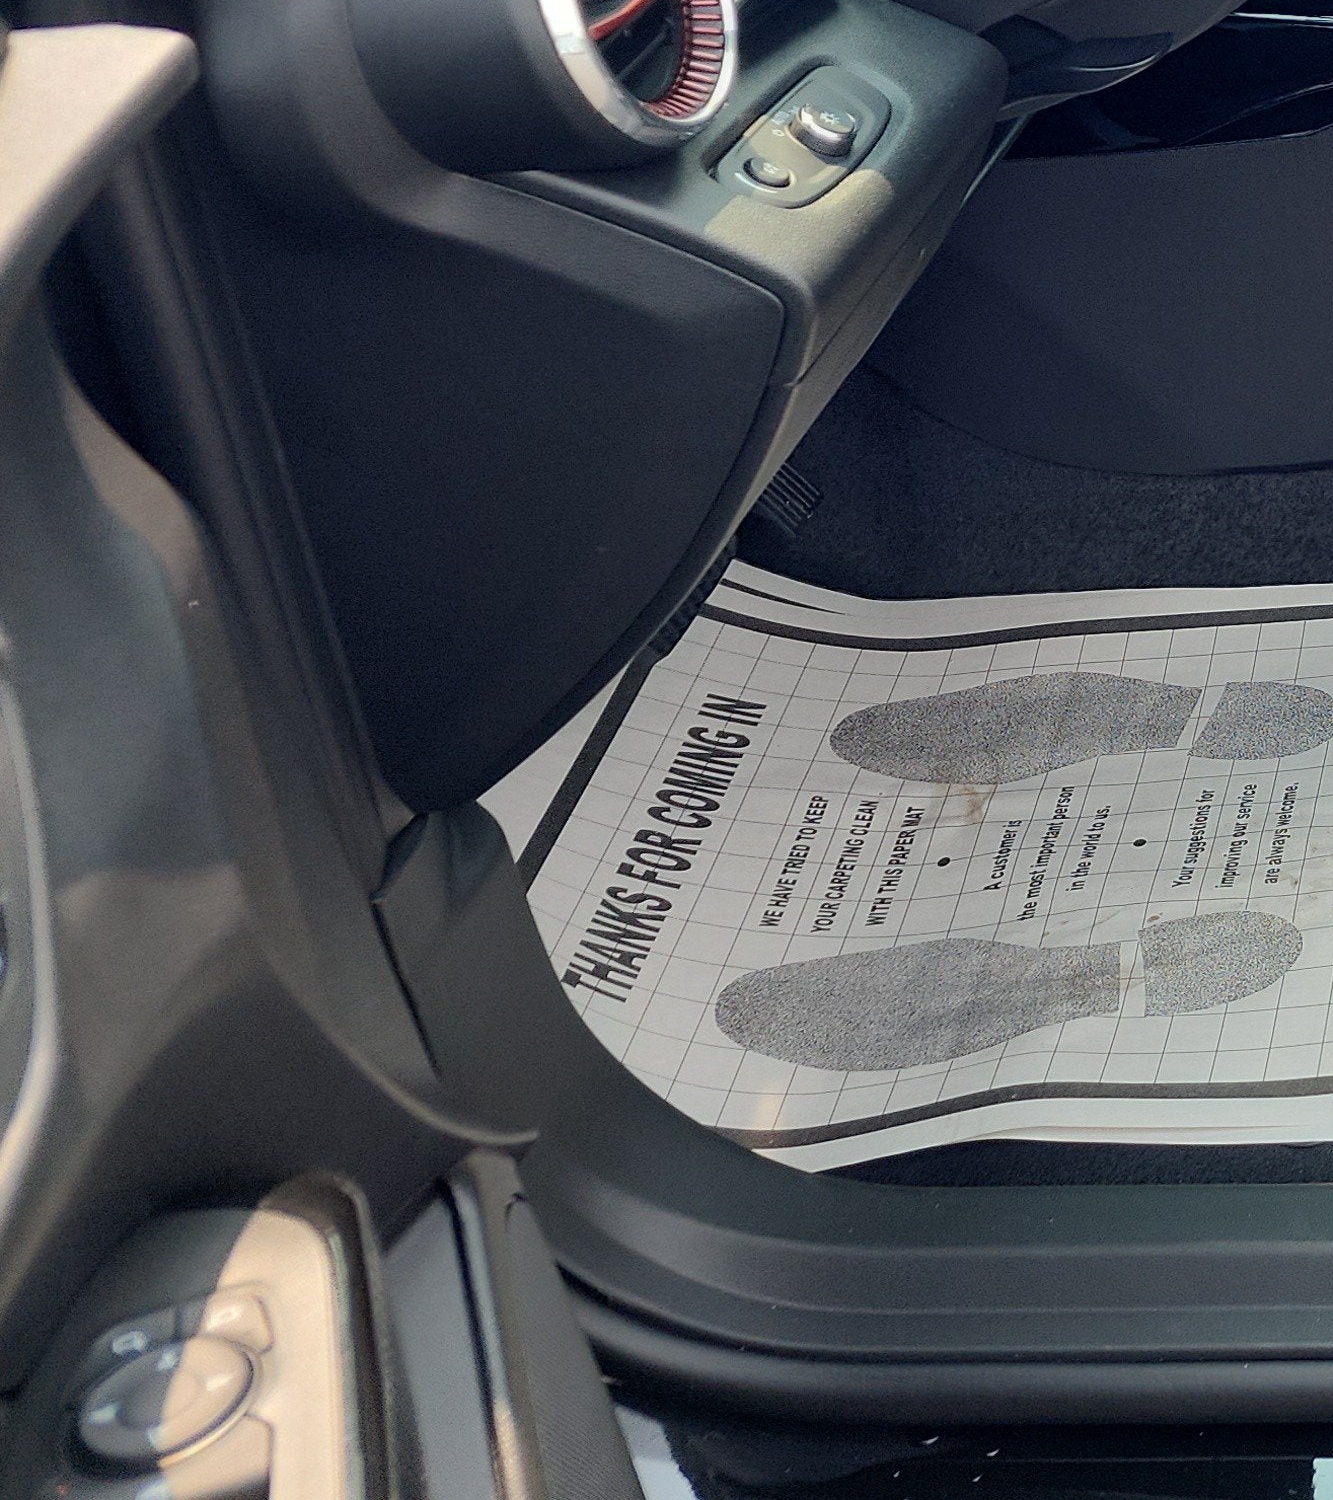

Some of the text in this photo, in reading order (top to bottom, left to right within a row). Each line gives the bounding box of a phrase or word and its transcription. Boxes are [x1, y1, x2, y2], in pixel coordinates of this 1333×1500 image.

[560, 693, 767, 1002] THANKS FOR COMING IN
[759, 795, 828, 927] WE HAVE TRIED TO KEEP
[811, 800, 879, 933] YOUR CARPETING CLEAN
[865, 806, 925, 926] WITH THIS PAPER MAT
[983, 820, 1022, 891] A customer is
[1017, 786, 1075, 921] the most important person
[1071, 861, 1091, 878] the
[1080, 834, 1101, 859] world
[1087, 822, 1106, 832] to
[1172, 789, 1215, 888] Your suggestions for
[1215, 784, 1257, 888] improving our service
[1265, 828, 1291, 866] always
[1065, 880, 1085, 891] in
[1264, 868, 1280, 884] are
